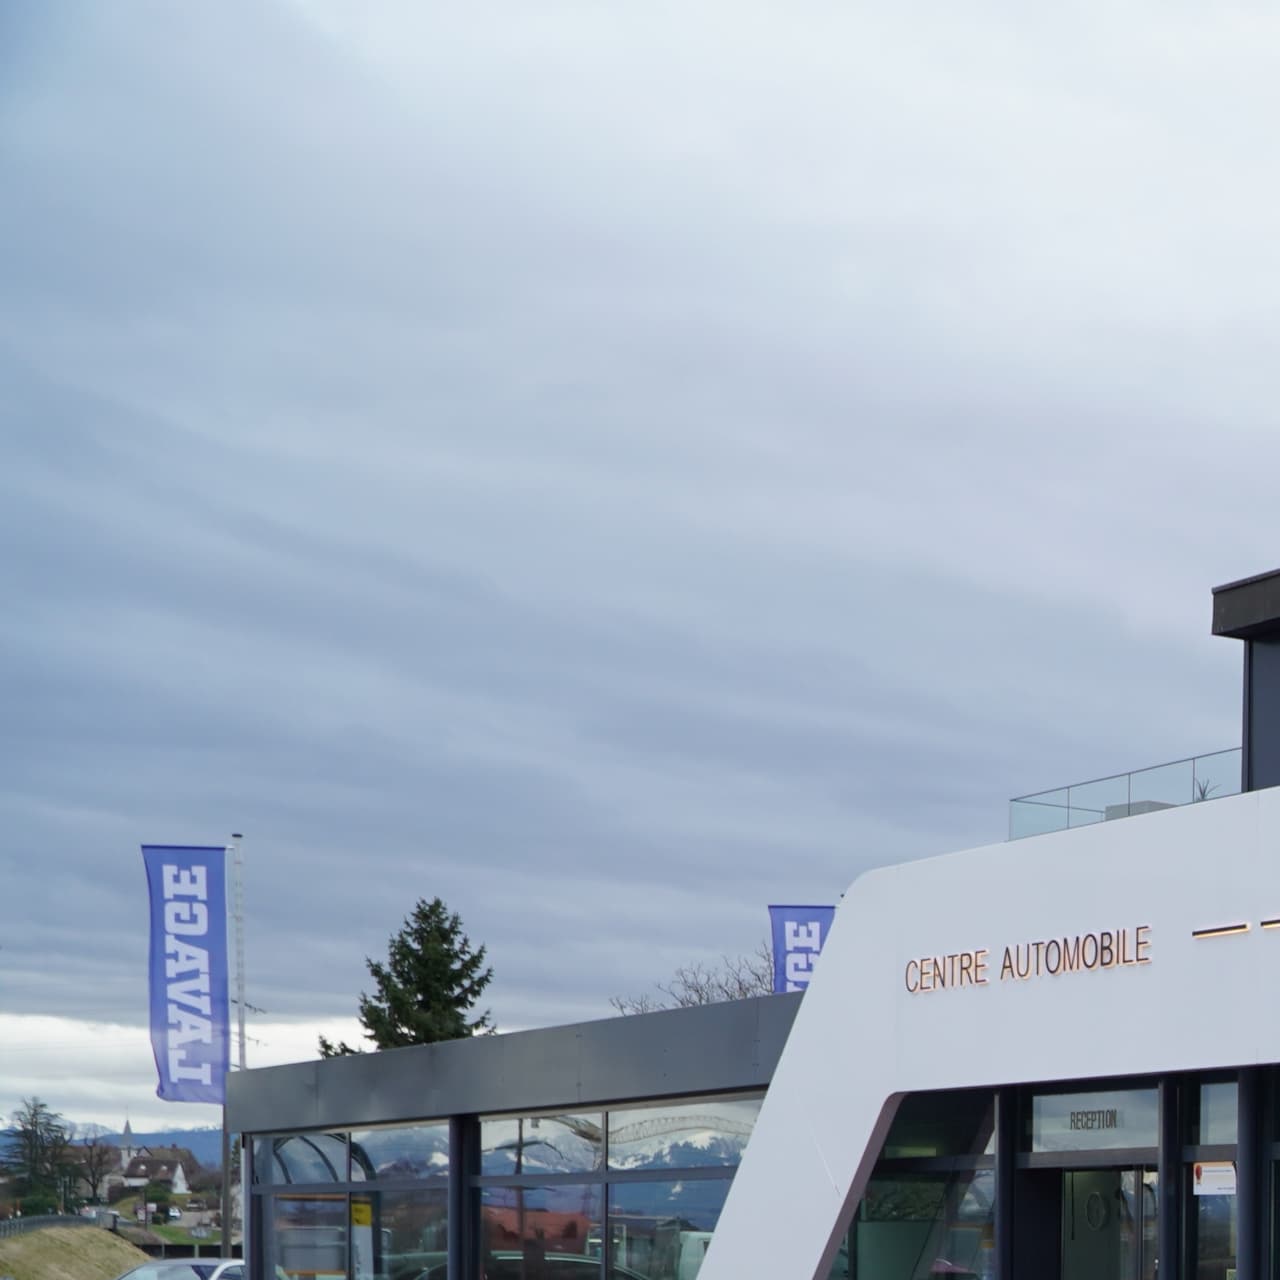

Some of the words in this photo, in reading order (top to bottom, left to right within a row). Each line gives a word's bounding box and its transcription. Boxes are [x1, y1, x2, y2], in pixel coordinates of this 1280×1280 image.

[905, 950, 989, 994] CENTRE
[1000, 925, 1152, 981] AUTOMOBILE
[1070, 1109, 1118, 1130] RECEPTION
